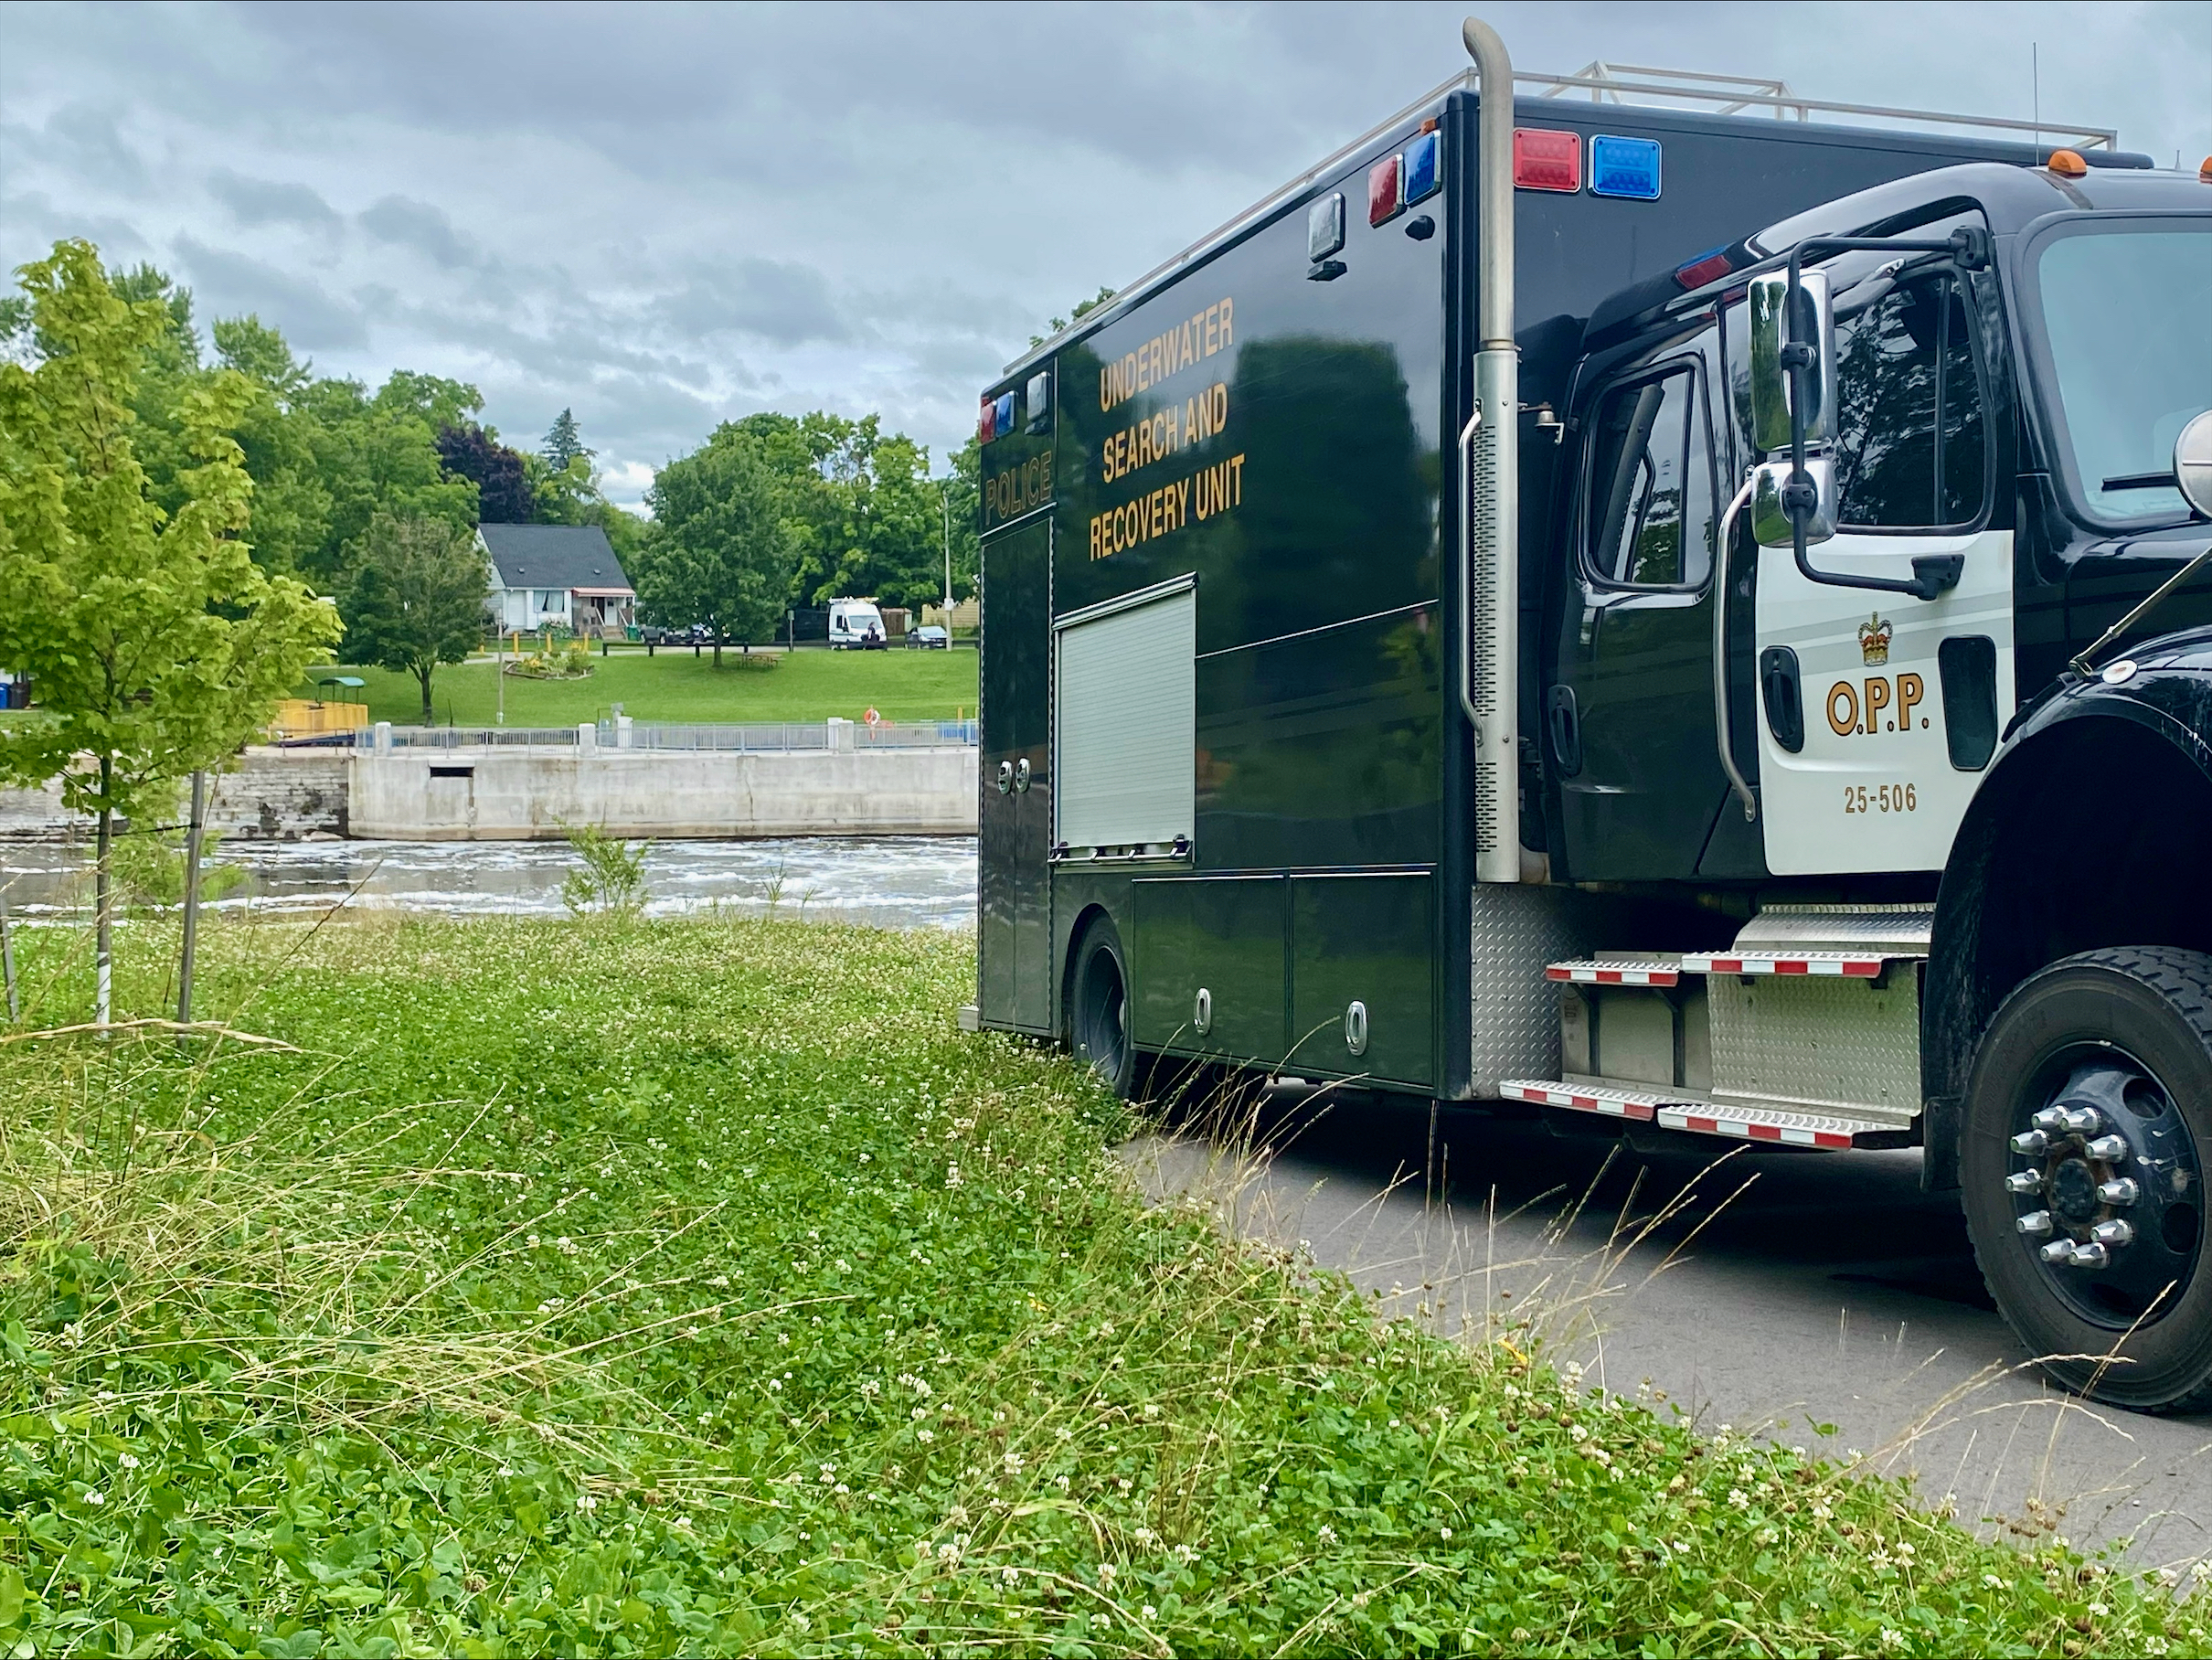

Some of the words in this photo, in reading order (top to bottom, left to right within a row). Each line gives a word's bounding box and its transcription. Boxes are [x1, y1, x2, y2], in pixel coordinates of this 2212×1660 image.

[1100, 297, 1234, 412] UNDERWATER
[1102, 404, 1178, 484] SEARCH
[1184, 382, 1228, 448] AND
[985, 450, 1052, 527] POLICE
[1090, 477, 1189, 561] RECOVERY
[1196, 453, 1245, 521] UNIT
[1827, 673, 1930, 737] O.P.P.
[1845, 783, 1917, 814] 25-506
